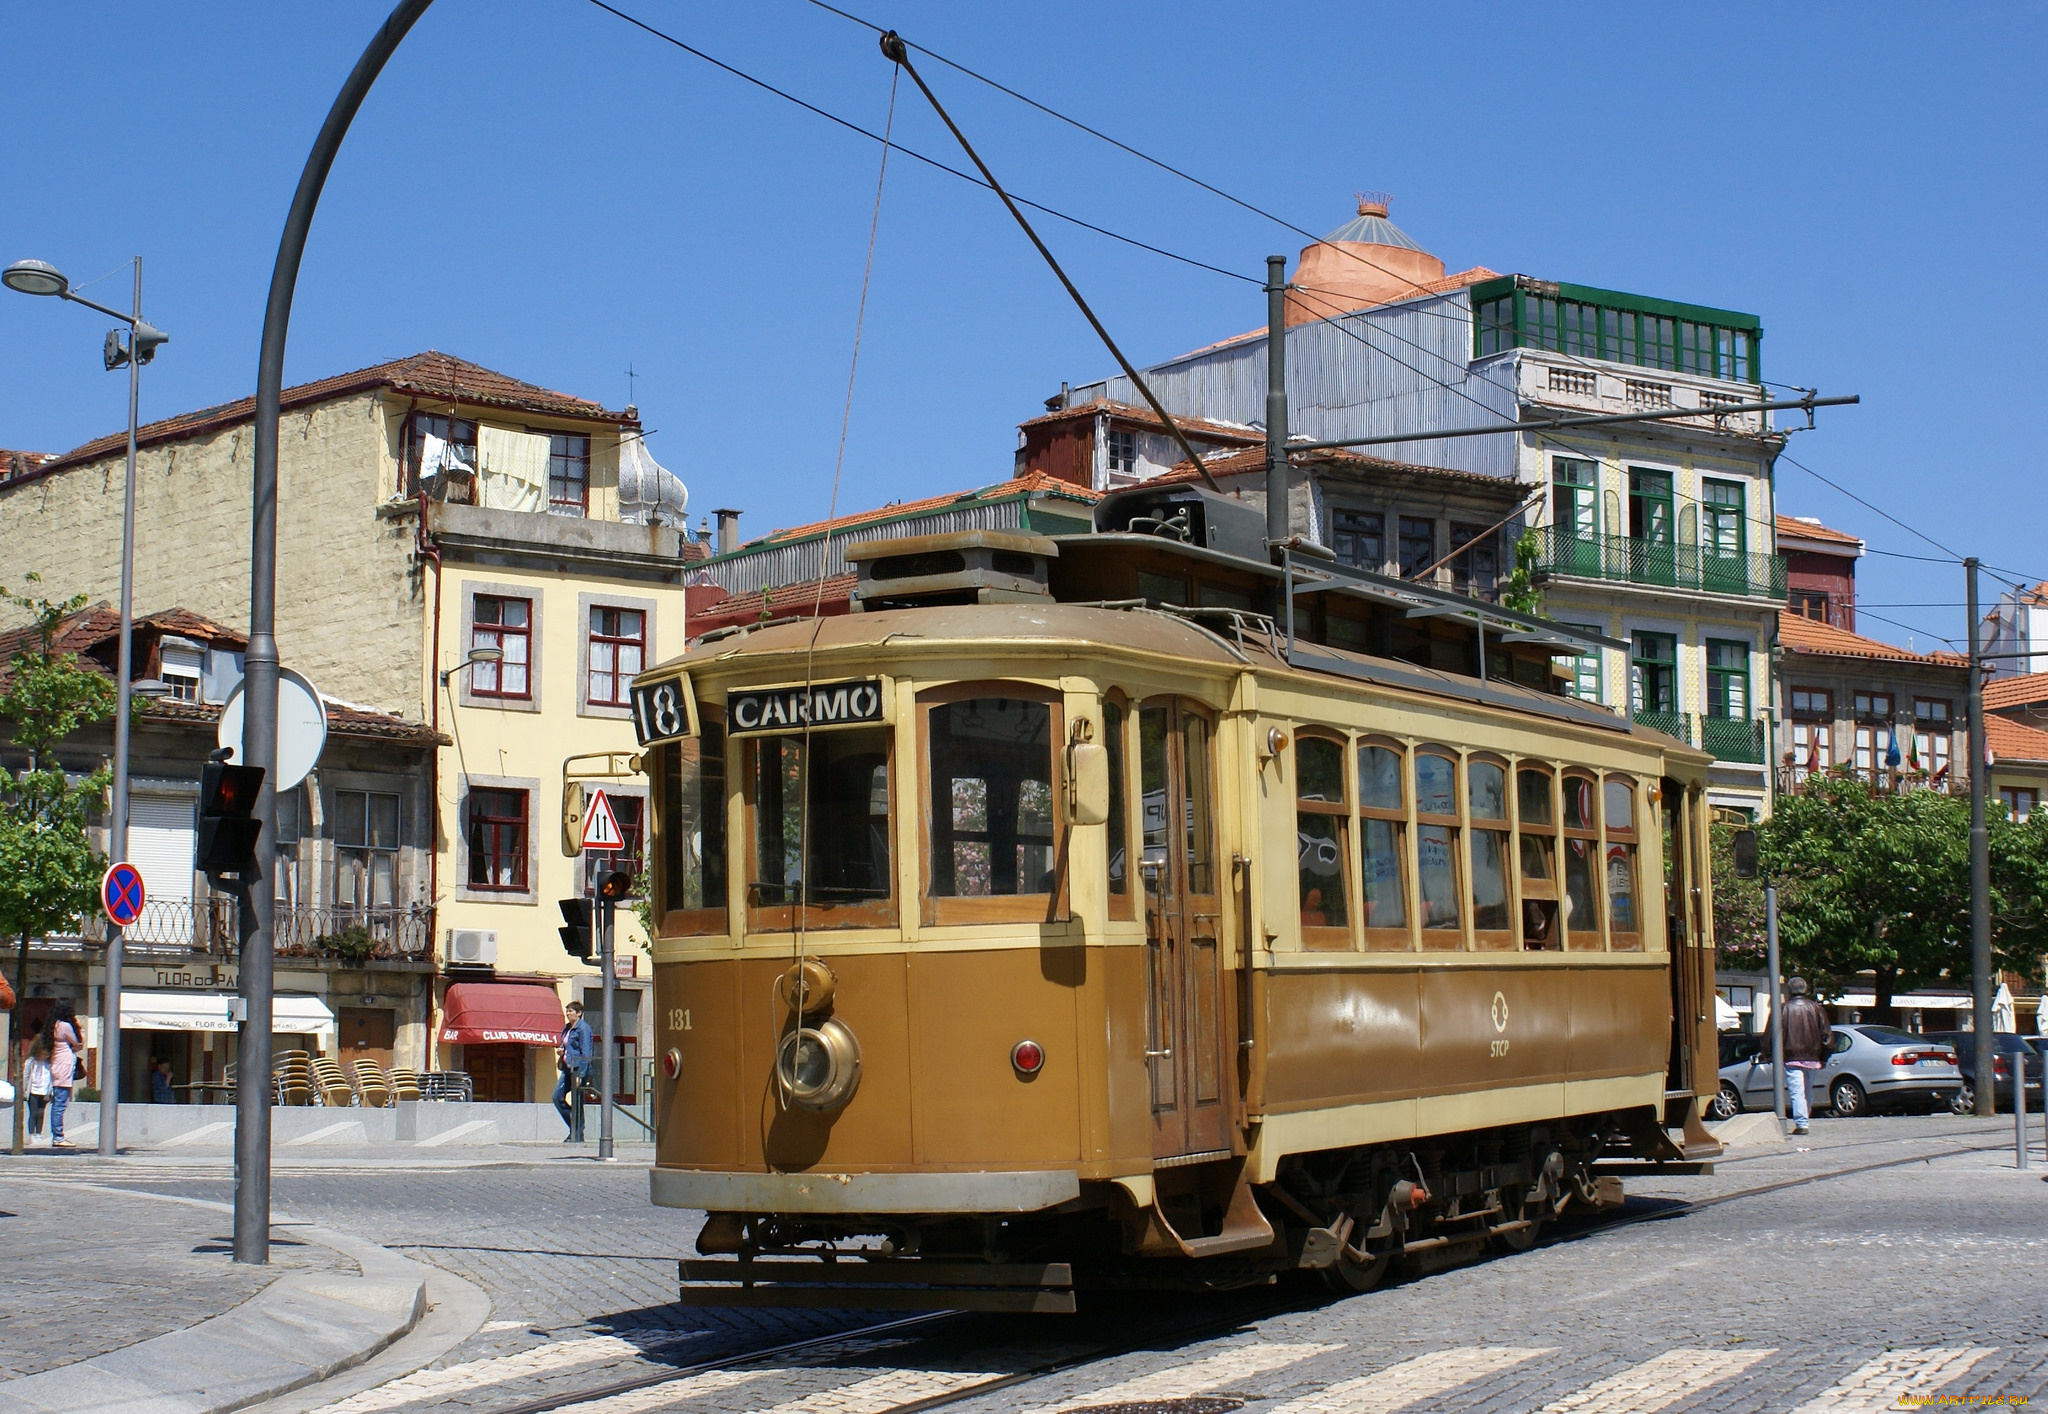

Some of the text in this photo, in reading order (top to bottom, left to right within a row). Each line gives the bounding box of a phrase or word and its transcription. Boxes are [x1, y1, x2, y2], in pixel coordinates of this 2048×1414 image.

[637, 685, 680, 741] 18
[734, 685, 878, 729] CARMO
[157, 972, 192, 985] FLOR
[195, 1020, 215, 1028] FLOR
[668, 1008, 692, 1031] 131
[443, 1030, 459, 1041] BAR
[482, 1031, 507, 1040] CLUB
[507, 1031, 552, 1043] TROPICAL
[1490, 1039, 1510, 1058] STCP
